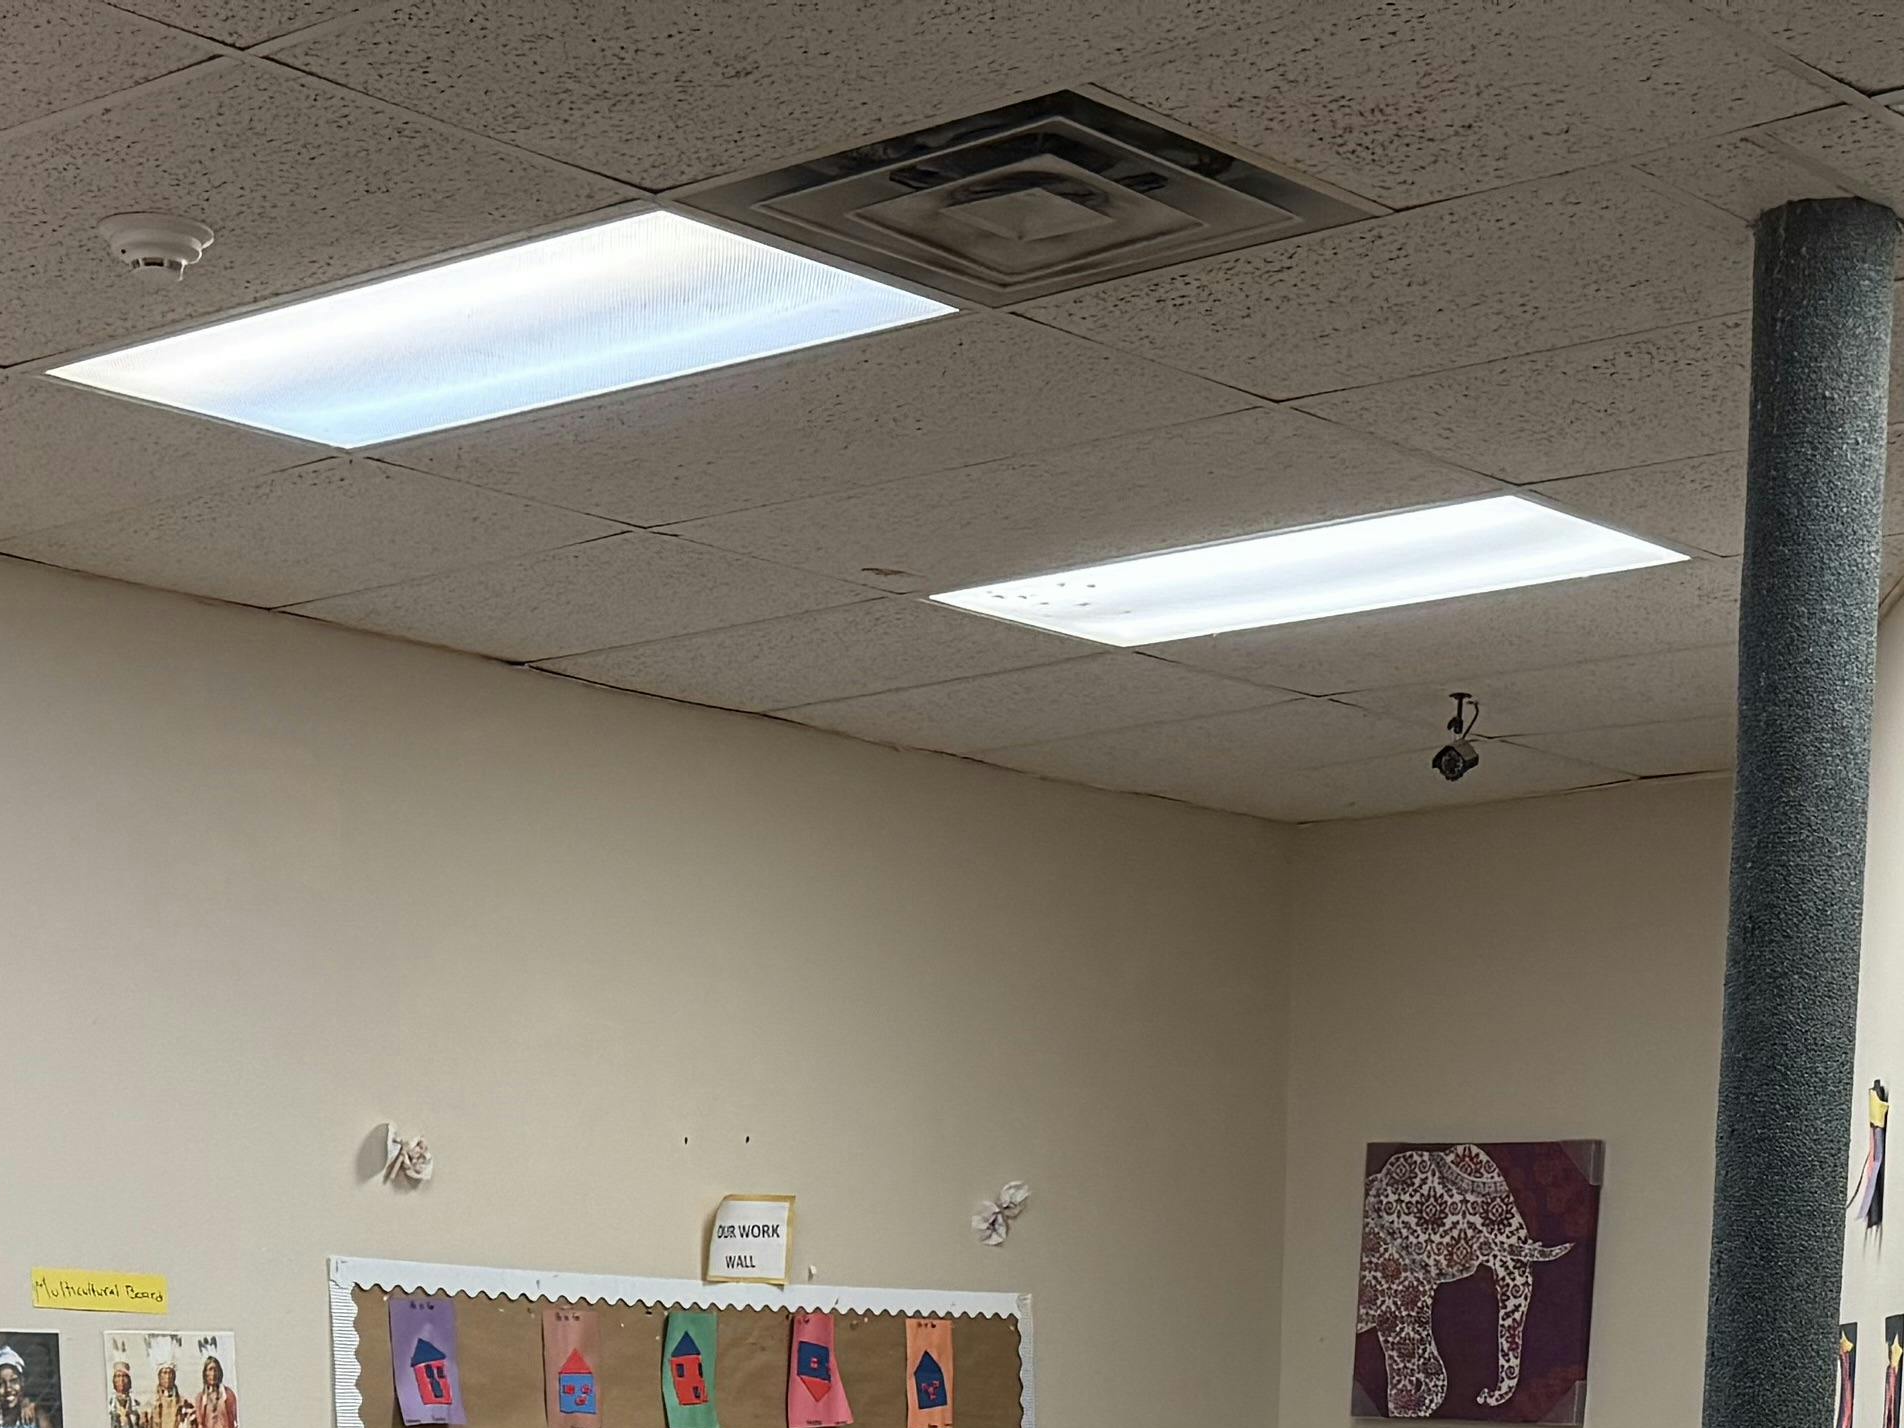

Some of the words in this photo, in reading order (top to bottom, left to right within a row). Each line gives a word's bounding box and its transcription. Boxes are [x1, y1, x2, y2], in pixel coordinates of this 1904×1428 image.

[717, 1224, 737, 1239] OUR
[738, 1224, 781, 1239] WORK
[725, 1255, 756, 1269] WALL
[35, 1277, 120, 1303] Multicultural
